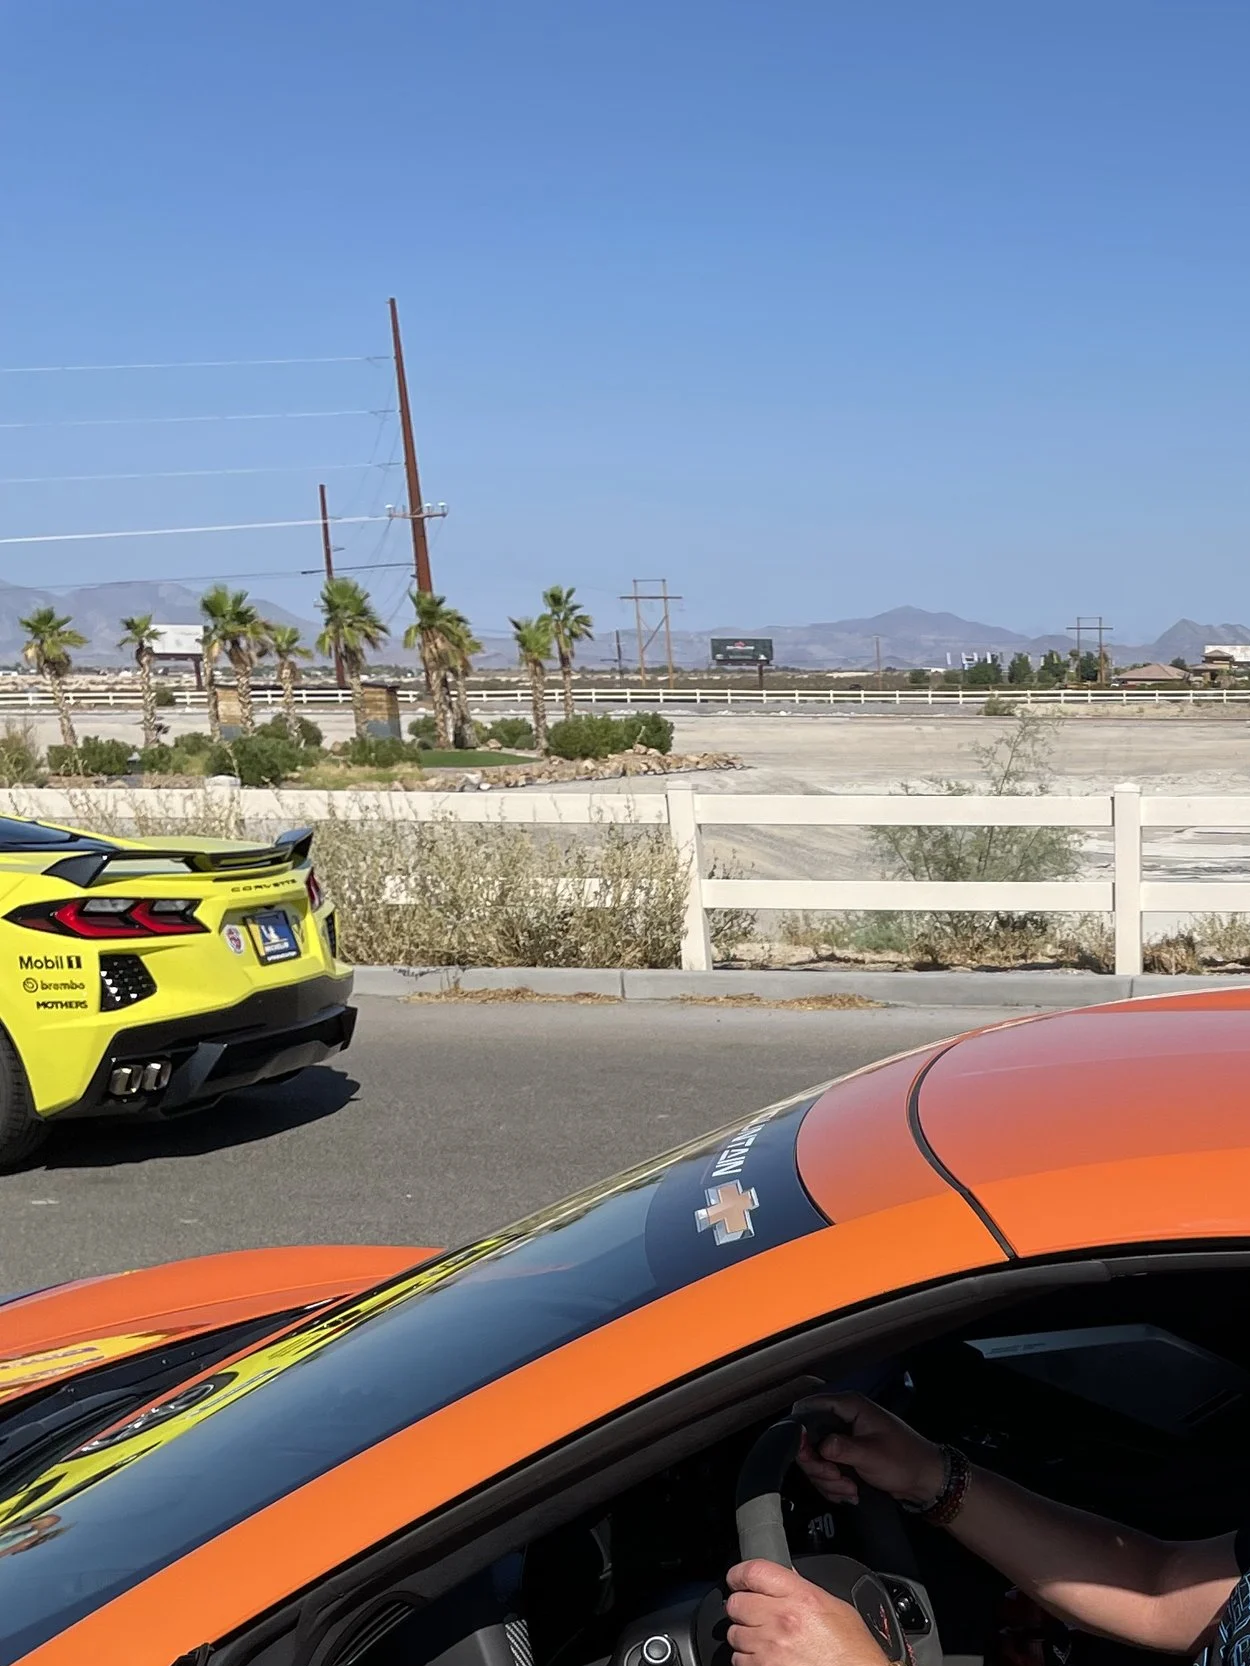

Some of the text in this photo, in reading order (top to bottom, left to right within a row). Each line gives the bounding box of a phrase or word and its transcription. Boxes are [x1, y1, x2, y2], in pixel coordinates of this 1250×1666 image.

[18, 955, 82, 969] Mobil 1
[40, 979, 85, 991] brembo
[36, 1000, 88, 1010] MOTHERS
